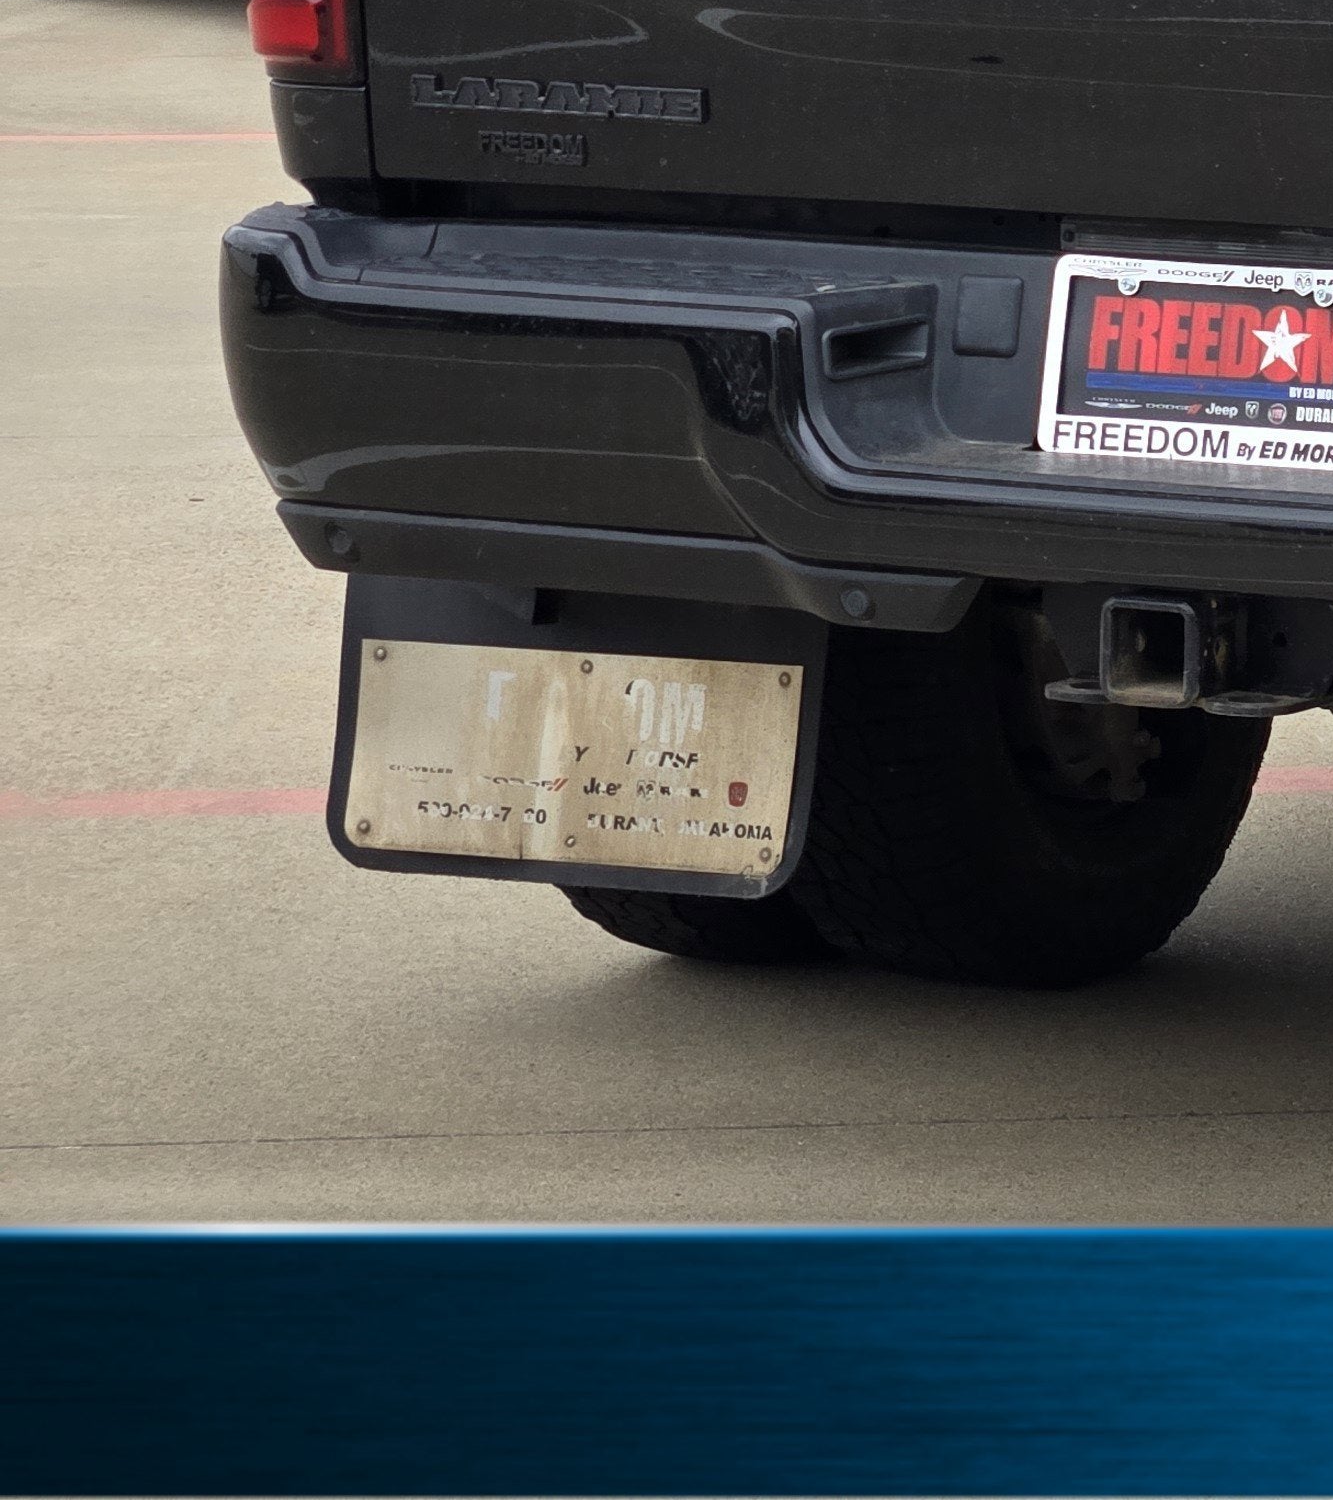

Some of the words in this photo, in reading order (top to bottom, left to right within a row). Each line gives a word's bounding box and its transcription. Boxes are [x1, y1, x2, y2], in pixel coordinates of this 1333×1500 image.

[1157, 268, 1224, 279] DODGE
[1244, 269, 1284, 289] Jeep
[1289, 386, 1302, 398] BY
[1303, 387, 1315, 399] ED
[1205, 402, 1239, 418] Jeep
[1052, 420, 1230, 459] FREEDOM
[1259, 441, 1287, 460] ED
